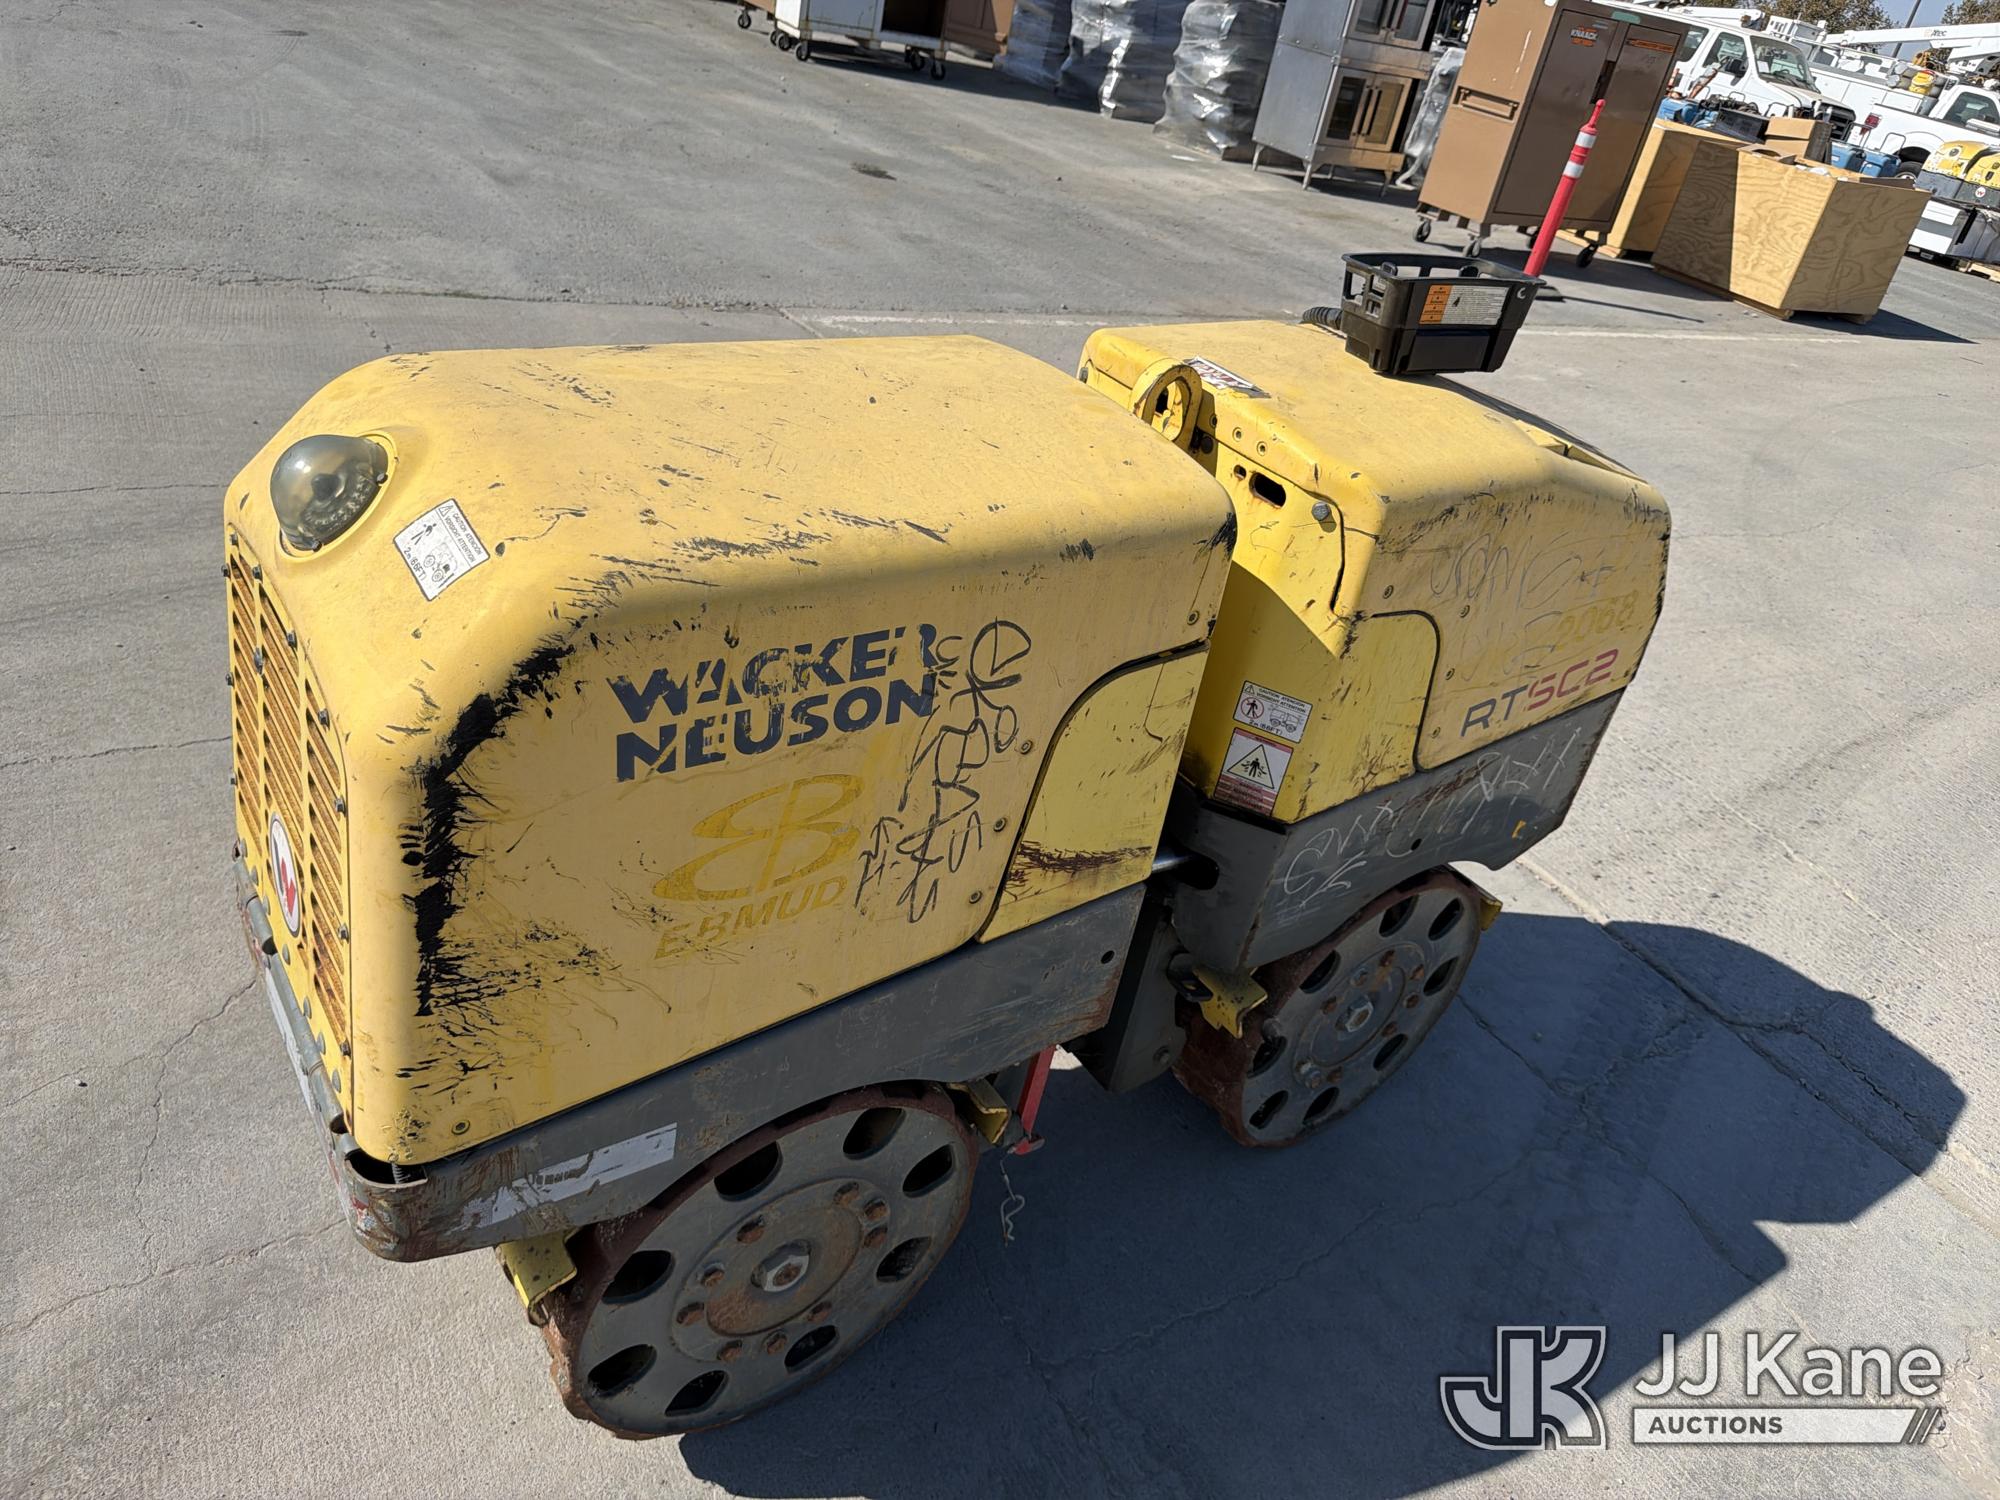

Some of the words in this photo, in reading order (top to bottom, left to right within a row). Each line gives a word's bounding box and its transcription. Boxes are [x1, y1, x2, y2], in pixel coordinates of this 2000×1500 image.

[452, 513, 468, 533] CAUTION
[458, 537, 477, 563] ATTENTION
[606, 623, 938, 724] WACKER
[617, 670, 938, 783] NEUSON
[654, 873, 848, 960] EBMUD
